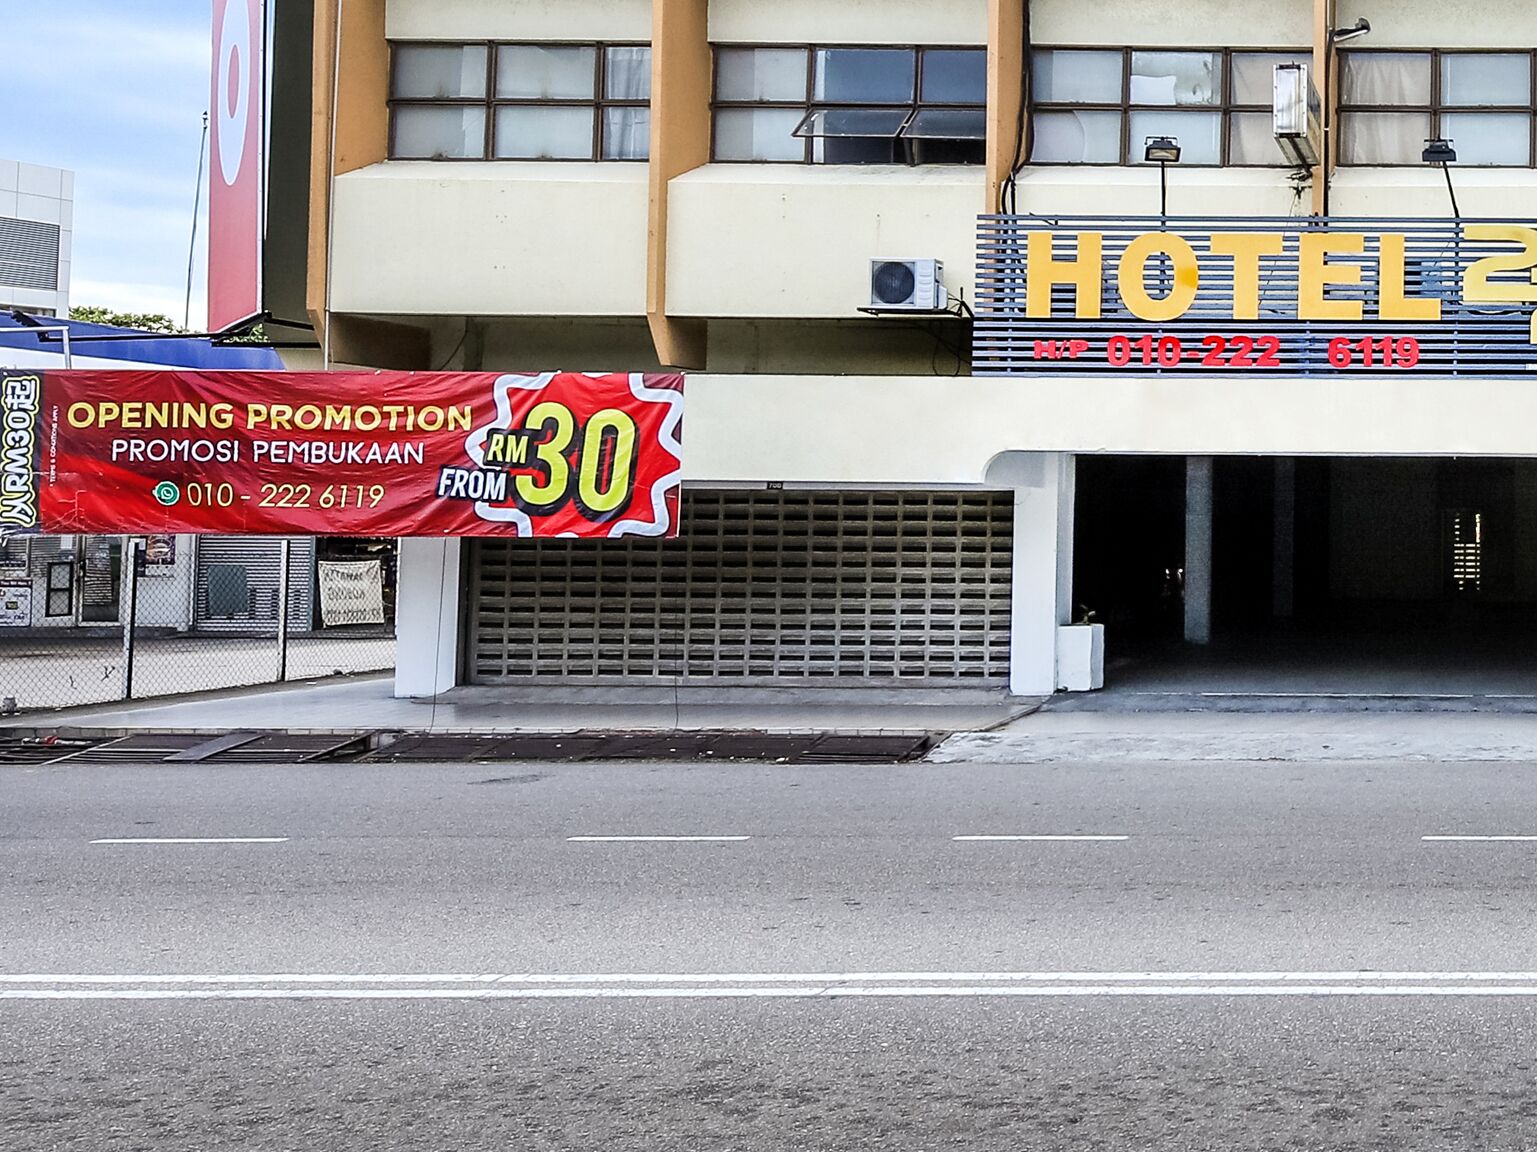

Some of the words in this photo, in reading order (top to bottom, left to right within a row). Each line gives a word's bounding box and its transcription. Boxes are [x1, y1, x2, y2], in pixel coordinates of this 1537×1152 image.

[1025, 230, 1441, 321] HOTEL
[1032, 339, 1089, 360] H/P
[1107, 335, 1281, 367] 010-222
[1327, 336, 1420, 367] 6119
[66, 401, 234, 430] OPENING
[246, 403, 473, 433] PROMOTION
[111, 439, 239, 465] PROMOSI
[252, 439, 425, 465] PEMBUKAAN
[486, 433, 529, 464] RM
[515, 401, 636, 512] 30
[187, 483, 233, 508] 010
[259, 482, 311, 509] 222
[318, 483, 384, 509] 6119
[438, 466, 507, 502] FROM
